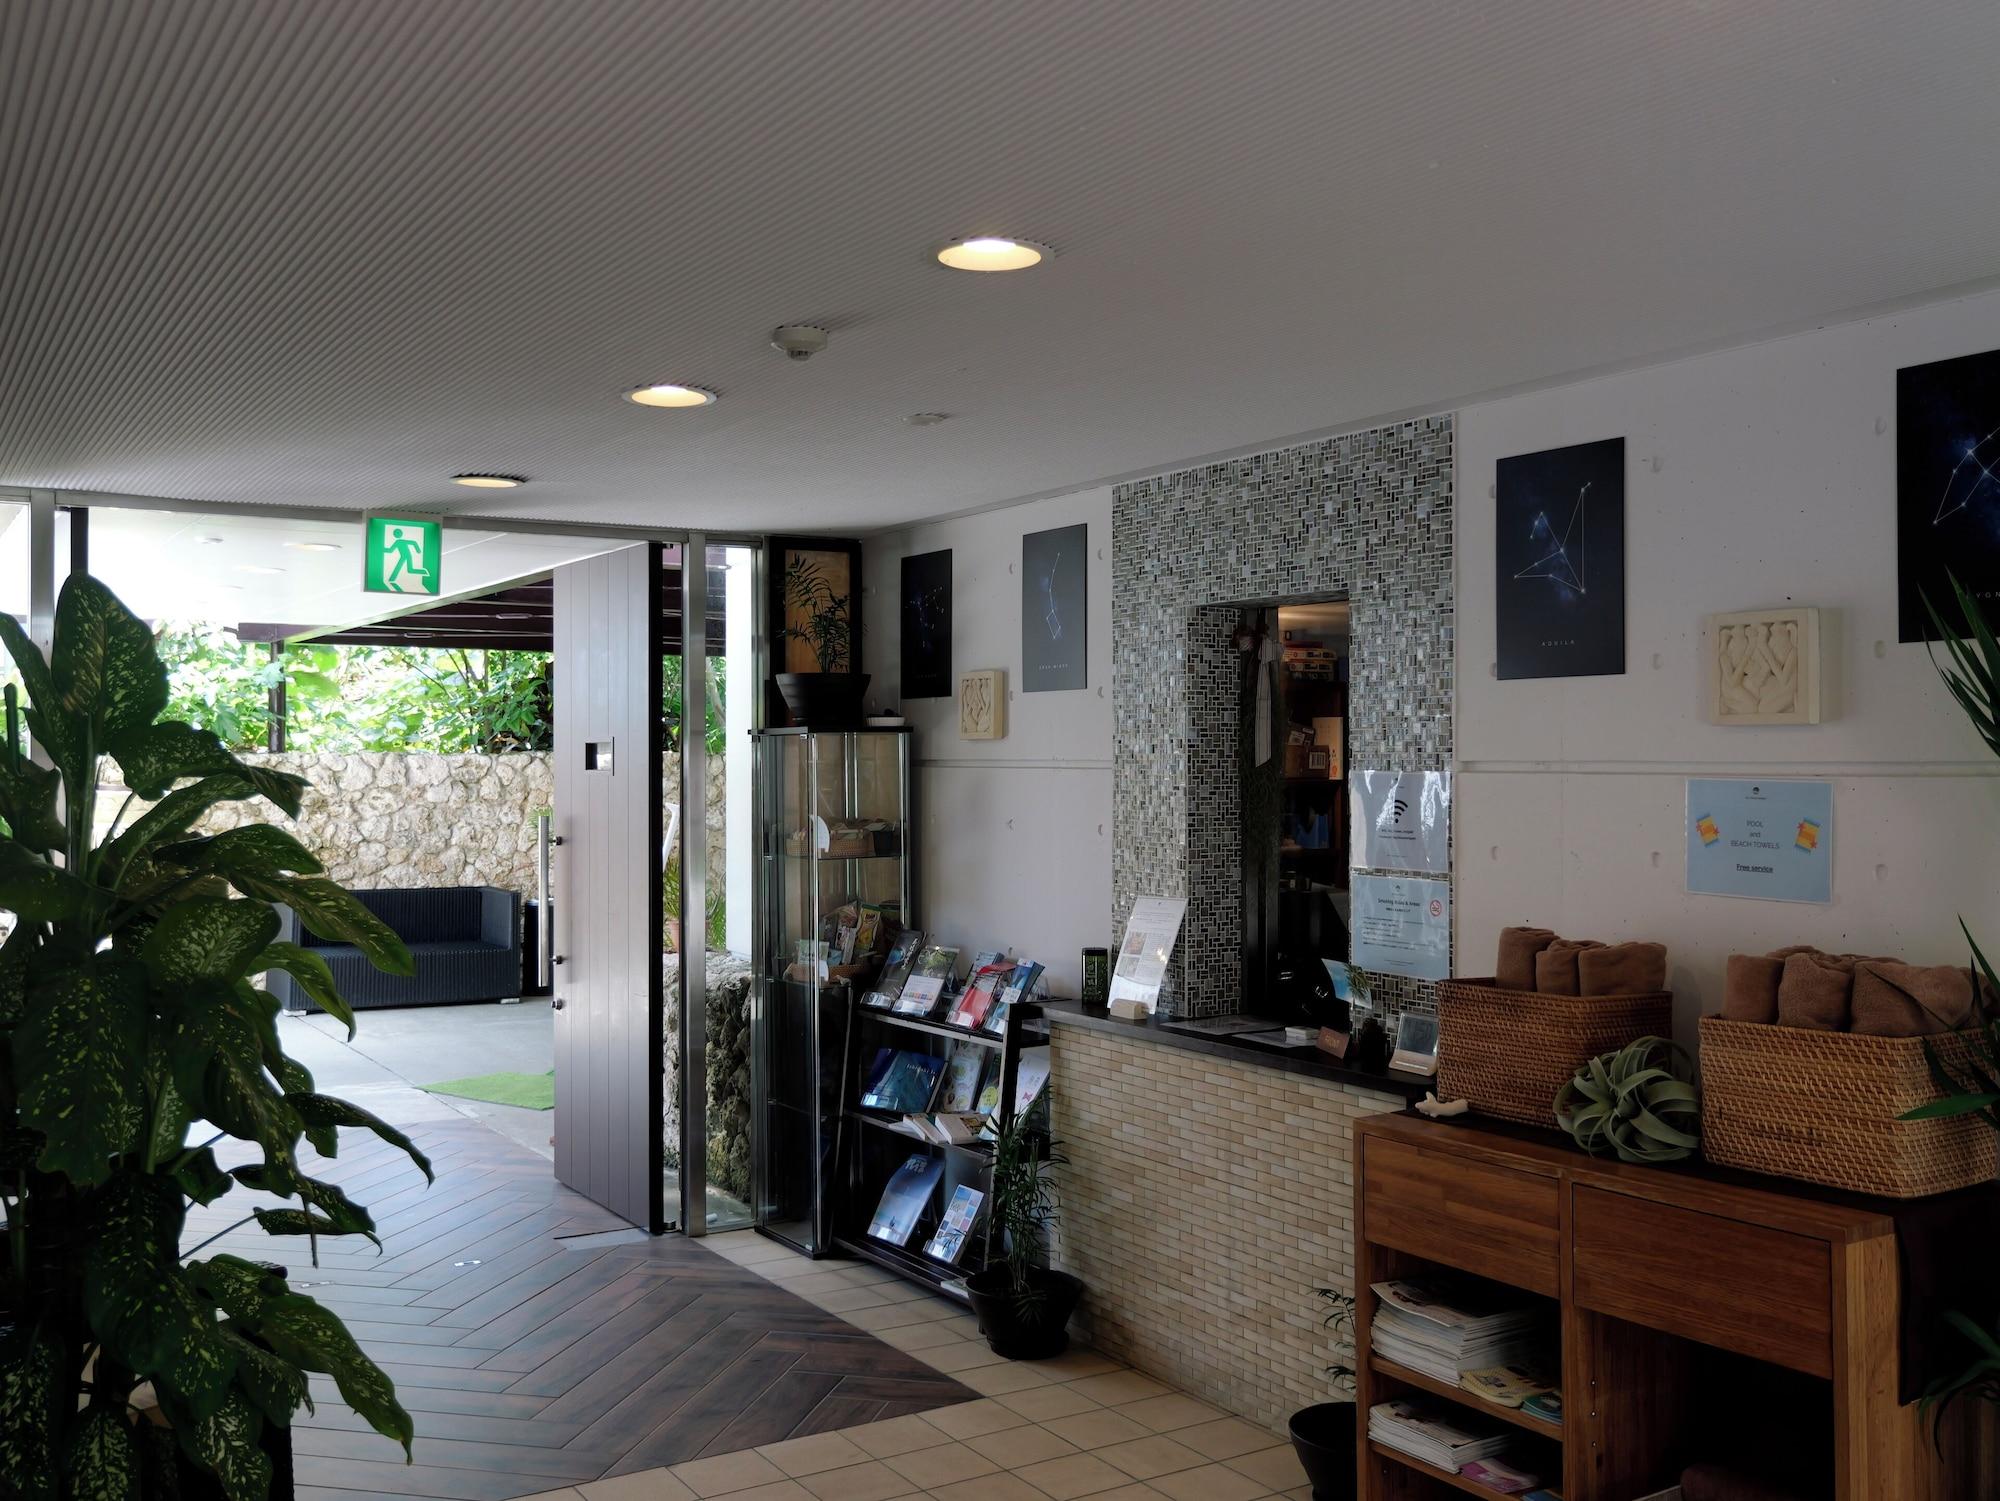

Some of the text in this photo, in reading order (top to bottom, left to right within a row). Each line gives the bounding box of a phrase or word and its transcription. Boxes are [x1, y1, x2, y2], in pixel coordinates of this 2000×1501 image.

[1541, 639, 1576, 647] AQUILA
[1746, 820, 1764, 828] POOL
[1730, 840, 1780, 850] BEACH TOWELS
[1736, 863, 1774, 873] Free service
